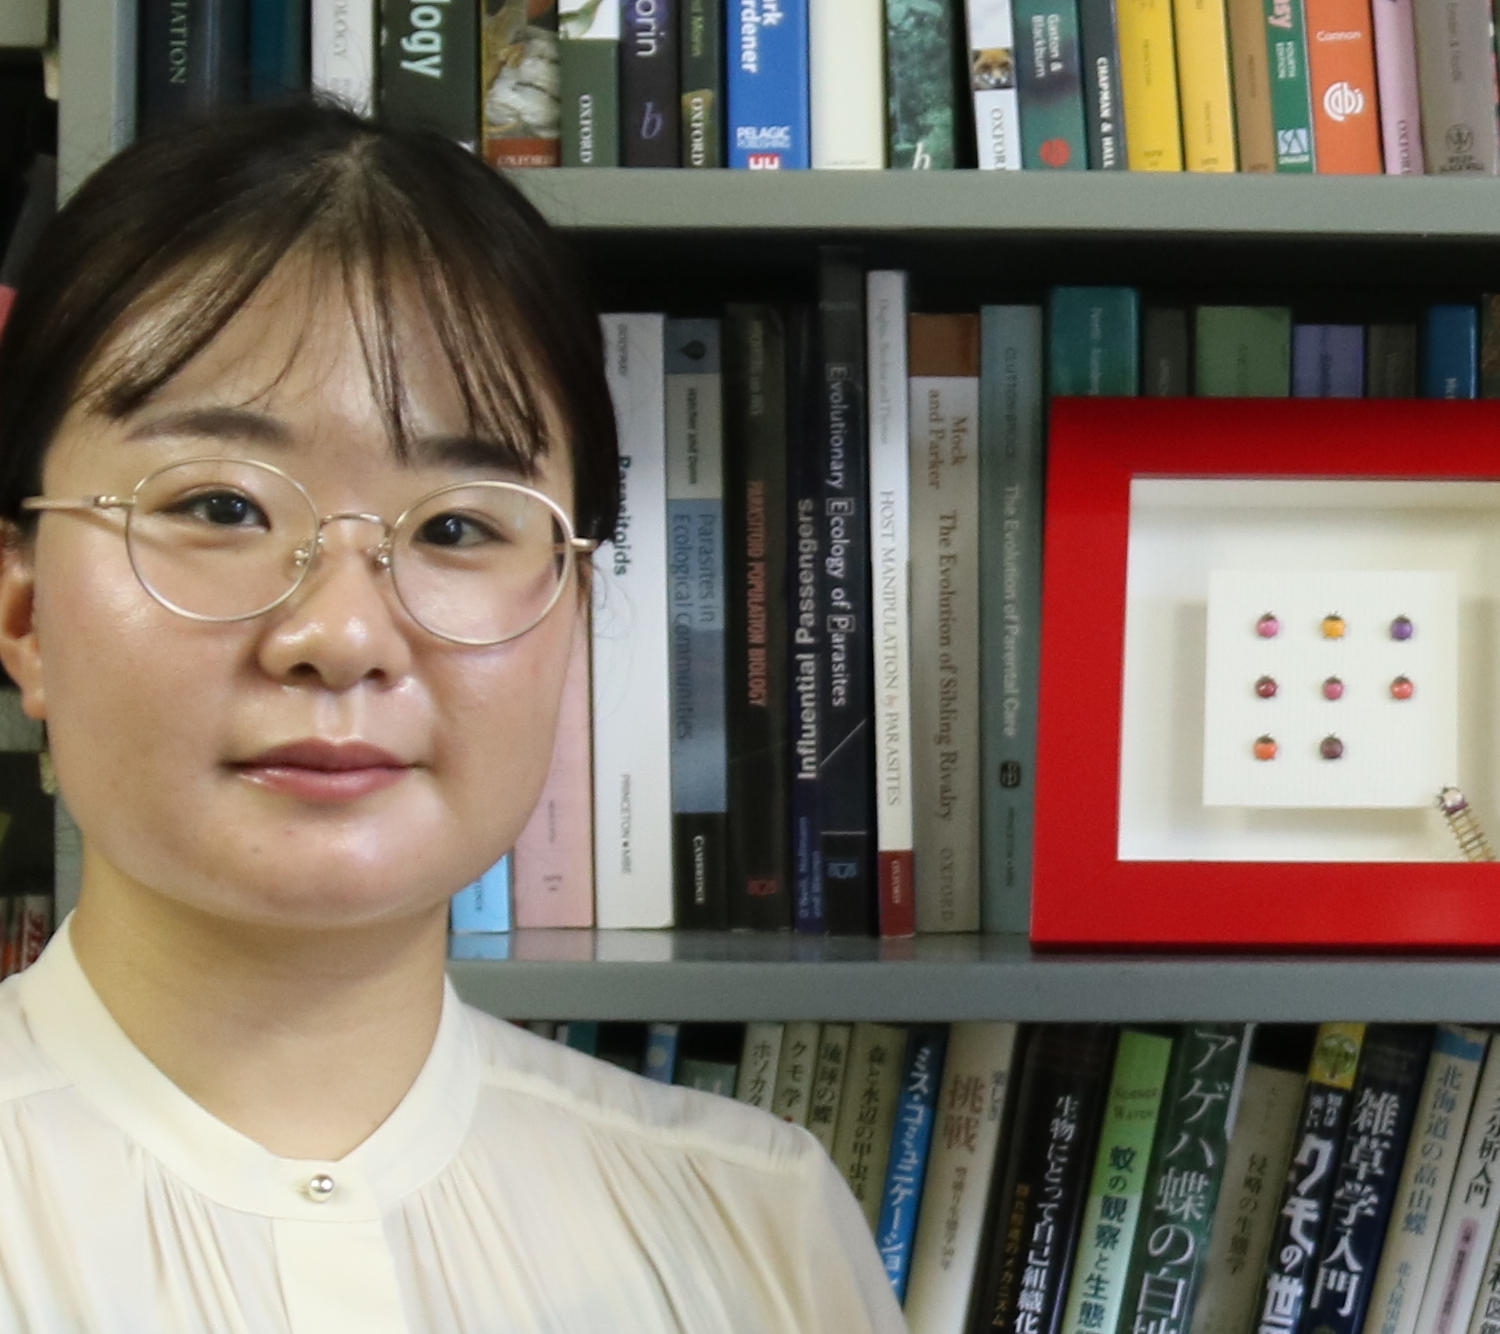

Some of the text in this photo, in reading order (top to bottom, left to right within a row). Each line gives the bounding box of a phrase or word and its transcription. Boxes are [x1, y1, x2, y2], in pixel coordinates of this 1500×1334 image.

[1096, 56, 1113, 125] CHAPMAN
[928, 429, 942, 490] Parker
[951, 417, 968, 467] Mock
[826, 363, 854, 708] Evolutionary Ecology Parasites
[796, 498, 821, 780] Influential Passengers
[933, 553, 958, 822] Evolution Sibling Rivalry
[942, 1074, 983, 1155] 挑戦
[1310, 1087, 1400, 1318] 雑草学入門
